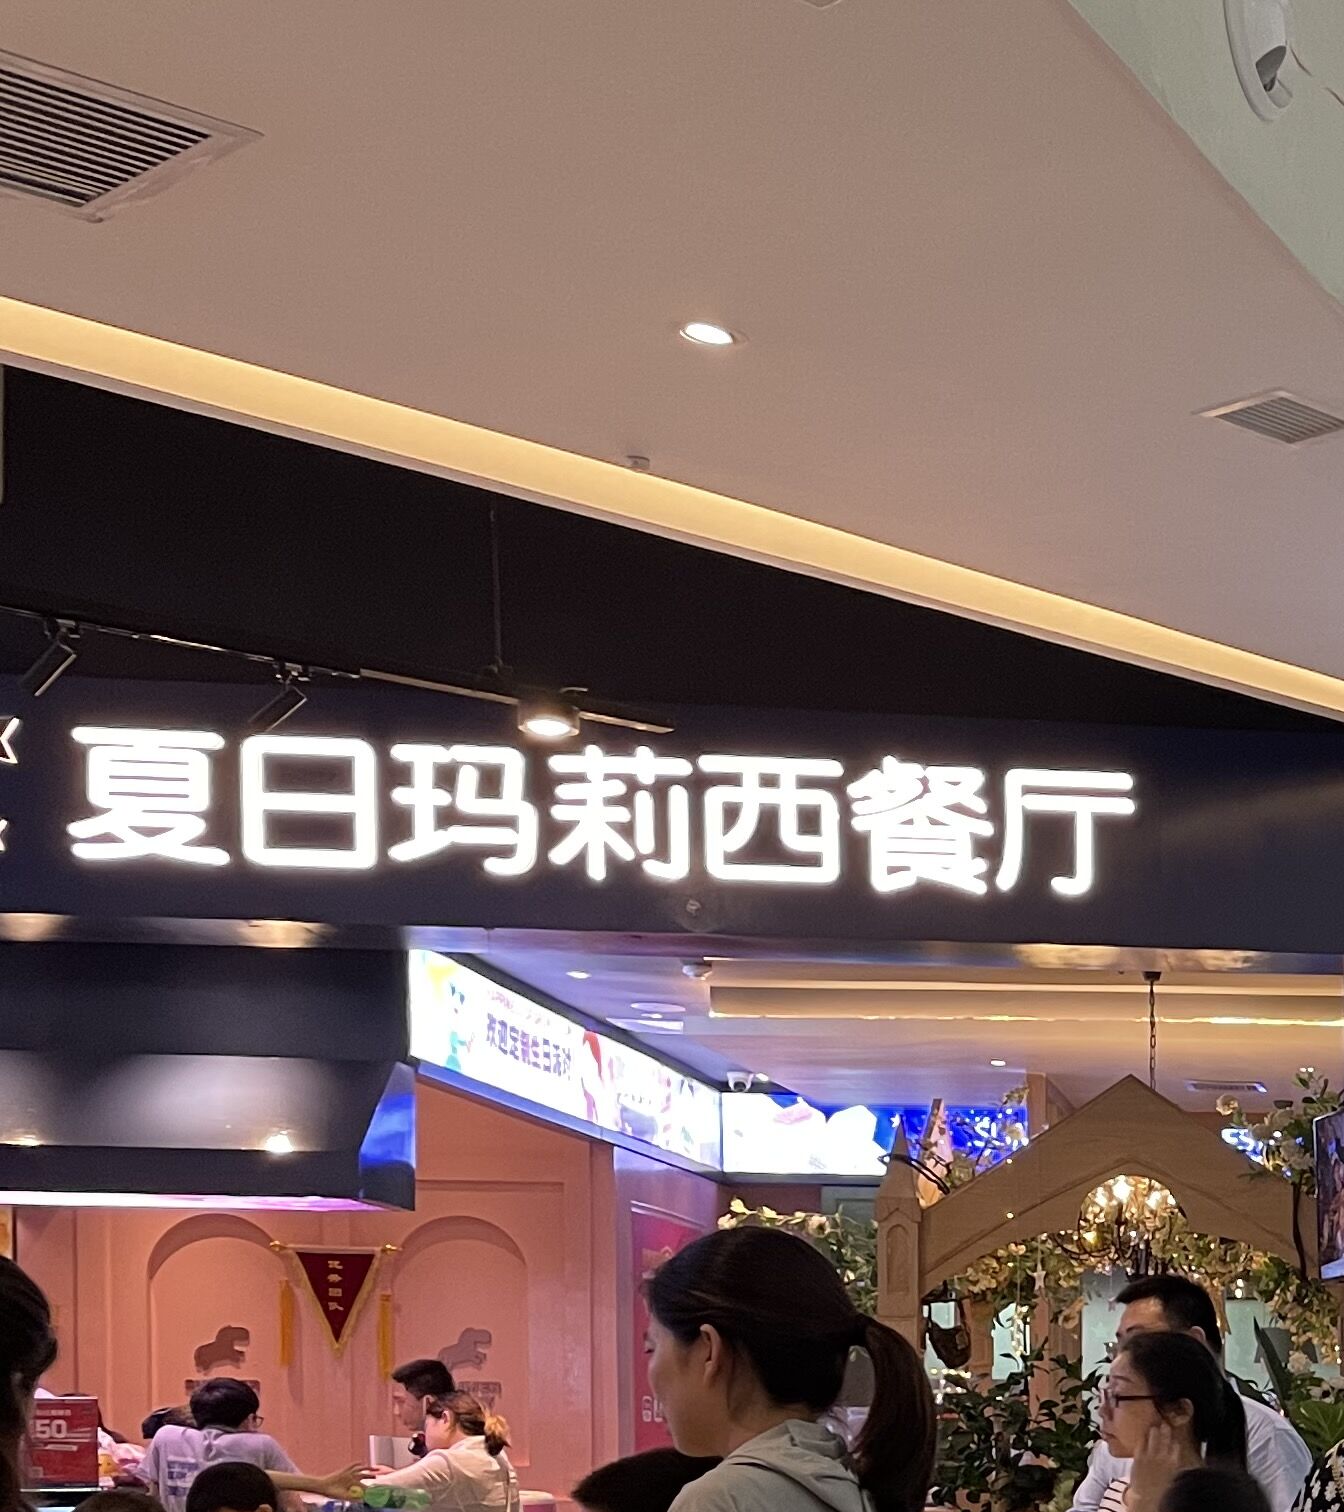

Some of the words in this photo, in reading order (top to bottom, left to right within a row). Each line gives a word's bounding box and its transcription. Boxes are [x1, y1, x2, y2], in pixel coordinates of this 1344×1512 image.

[66, 725, 1137, 896] 夏日玛莉西餐厅
